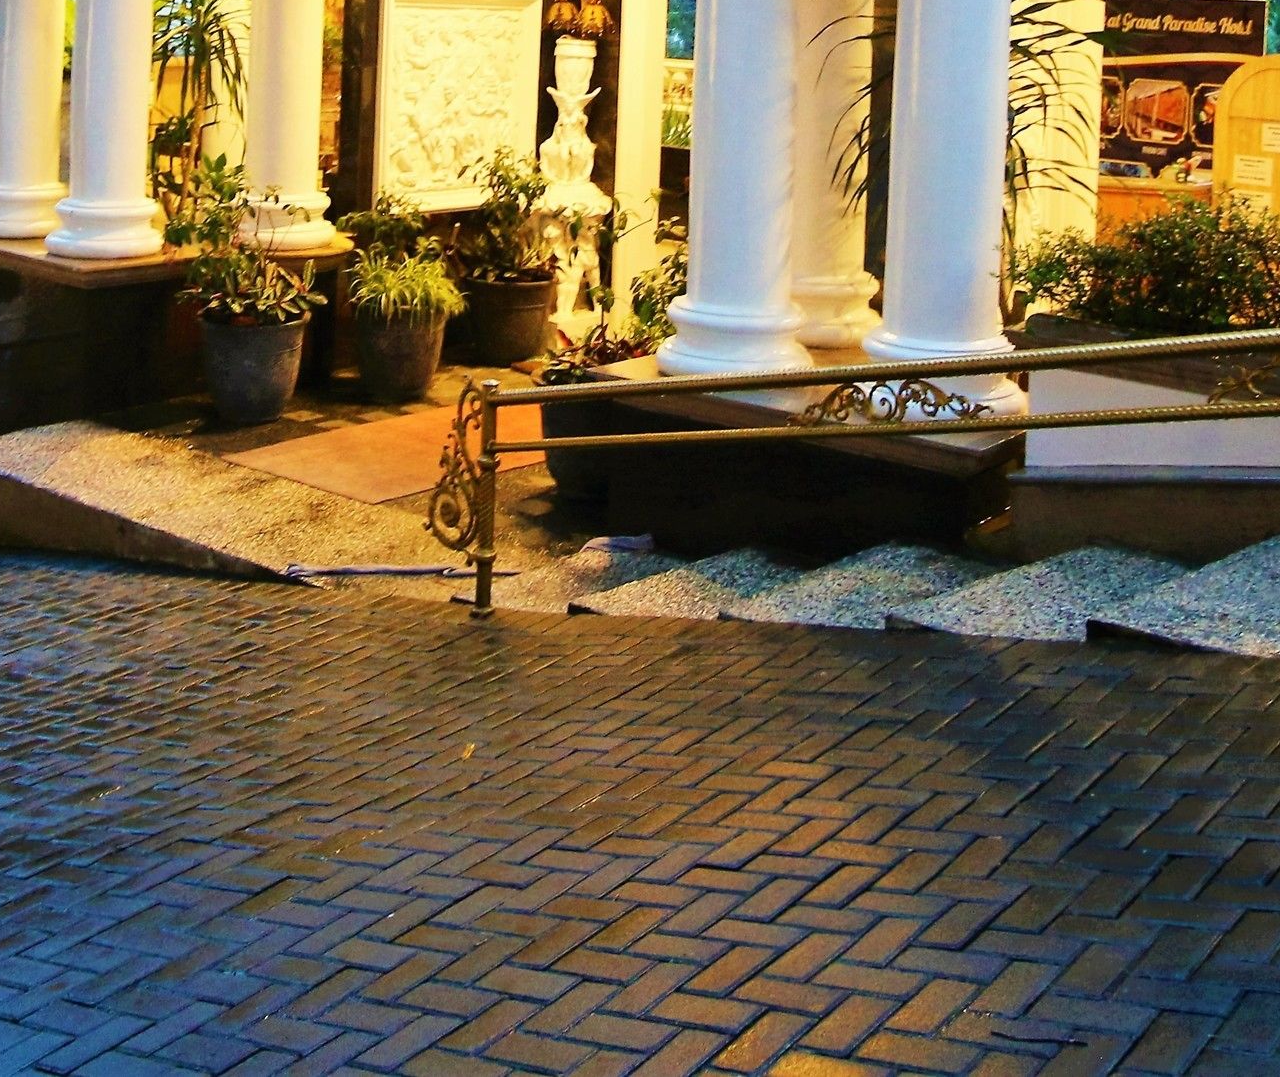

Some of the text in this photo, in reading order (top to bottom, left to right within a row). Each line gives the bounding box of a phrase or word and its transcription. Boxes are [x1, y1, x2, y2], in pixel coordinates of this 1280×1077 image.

[1122, 13, 1161, 32] Grand
[1162, 14, 1217, 33] Paradise
[1219, 17, 1253, 35] Hotel
